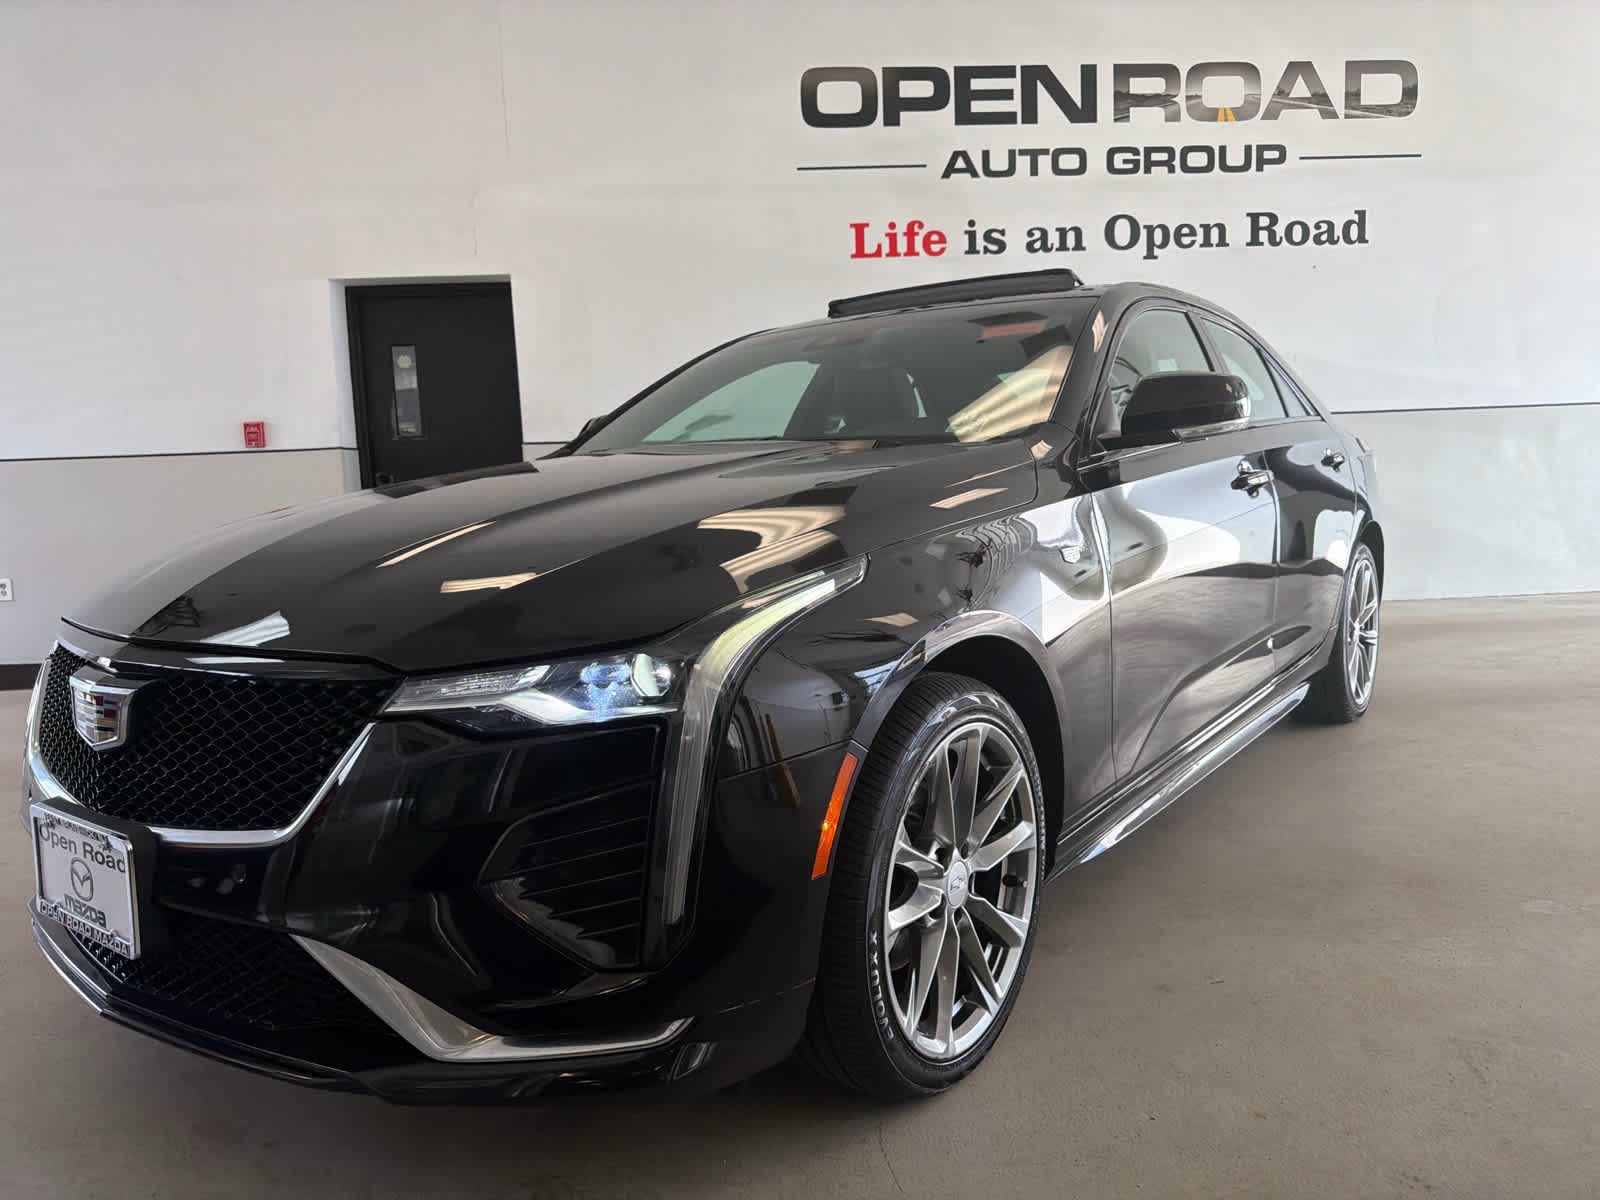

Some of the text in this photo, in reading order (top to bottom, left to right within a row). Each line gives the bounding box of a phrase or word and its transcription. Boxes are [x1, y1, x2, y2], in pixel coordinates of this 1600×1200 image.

[800, 60, 1418, 128] OPEN ROAD
[941, 144, 1286, 179] AUTO GROUP
[850, 210, 1368, 259] Life is an Open Road
[39, 822, 78, 854] Open
[83, 840, 125, 873] Road
